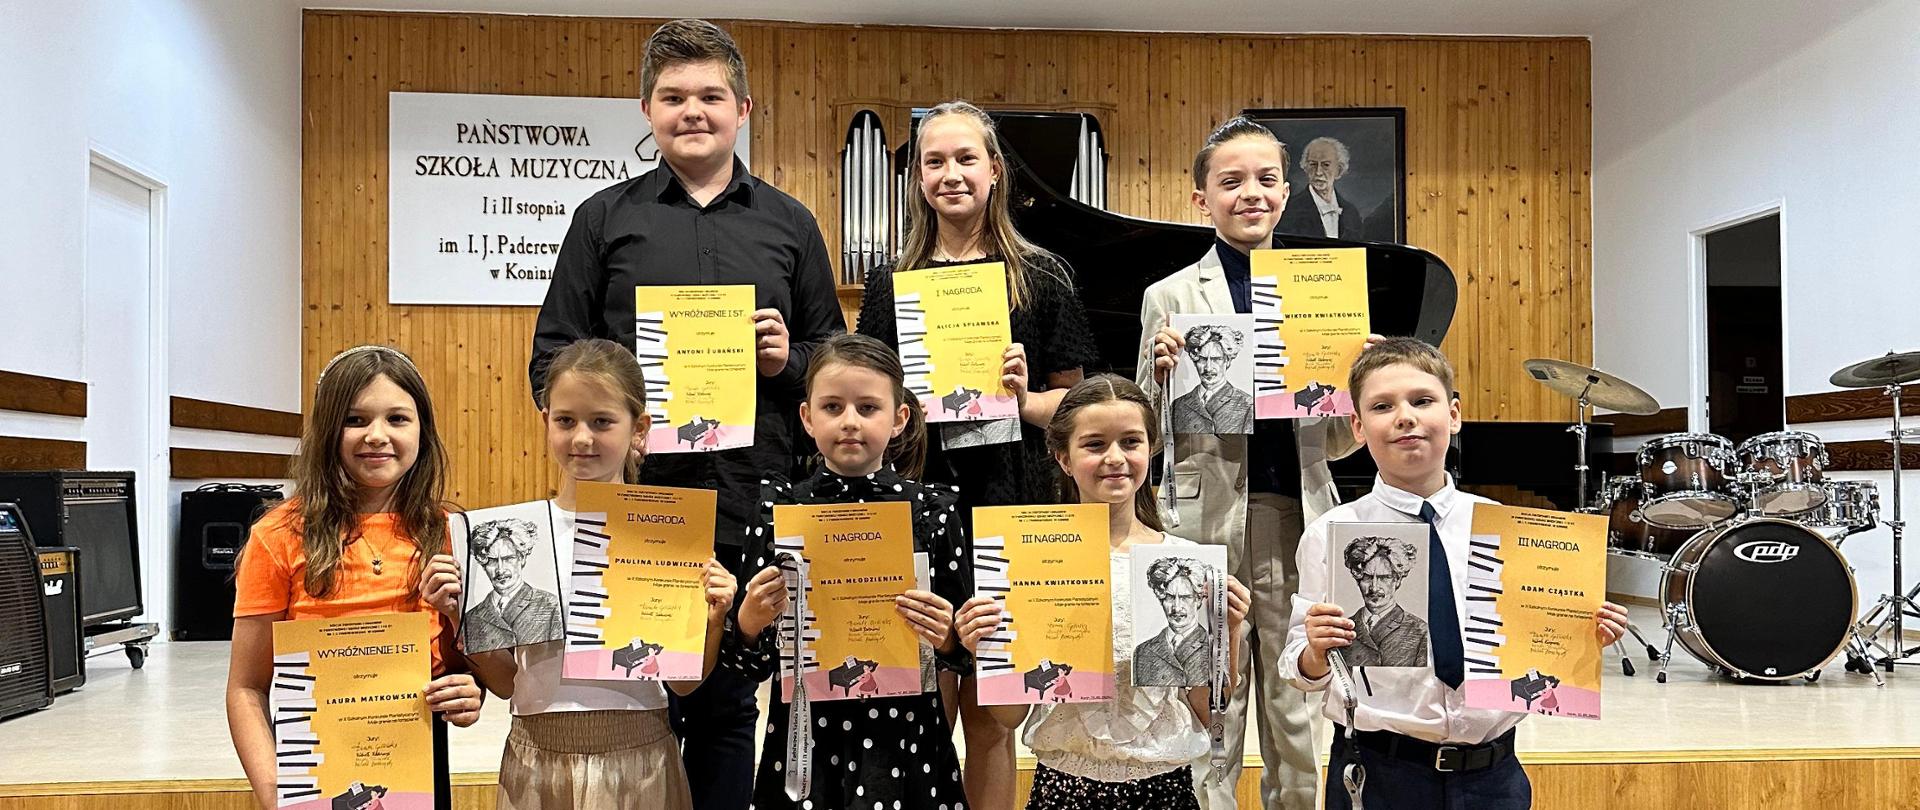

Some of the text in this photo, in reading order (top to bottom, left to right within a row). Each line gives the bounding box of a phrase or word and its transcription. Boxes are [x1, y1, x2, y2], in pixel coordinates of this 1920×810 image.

[456, 118, 590, 146] PAŃSTWOWA
[415, 155, 630, 179] SZKOŁA MUZYCZNA
[493, 198, 497, 214] i
[516, 197, 565, 221] stopnia
[439, 238, 458, 253] im
[498, 235, 560, 254] Paderew
[490, 269, 499, 280] w
[1301, 274, 1342, 282] NAGRODA
[943, 286, 982, 296] NAGRODA
[670, 310, 726, 318] WYRÓŻNIENIE
[637, 514, 686, 526] NAGRODA
[824, 531, 882, 543] I NAGRODA
[1022, 533, 1082, 544] III NAGRODA
[1518, 536, 1580, 552] III NAGRODA
[1751, 542, 1799, 561] pdp
[615, 558, 704, 569] PAULINA LUDWICZAK
[846, 576, 904, 584] MŁODZIENIAK
[1521, 585, 1585, 598] ADAM CZĄSTKA
[317, 646, 393, 659] WYRÓŻNIENIE
[402, 644, 418, 654] ST.
[326, 692, 418, 705] LAURA MATKOWSKA
